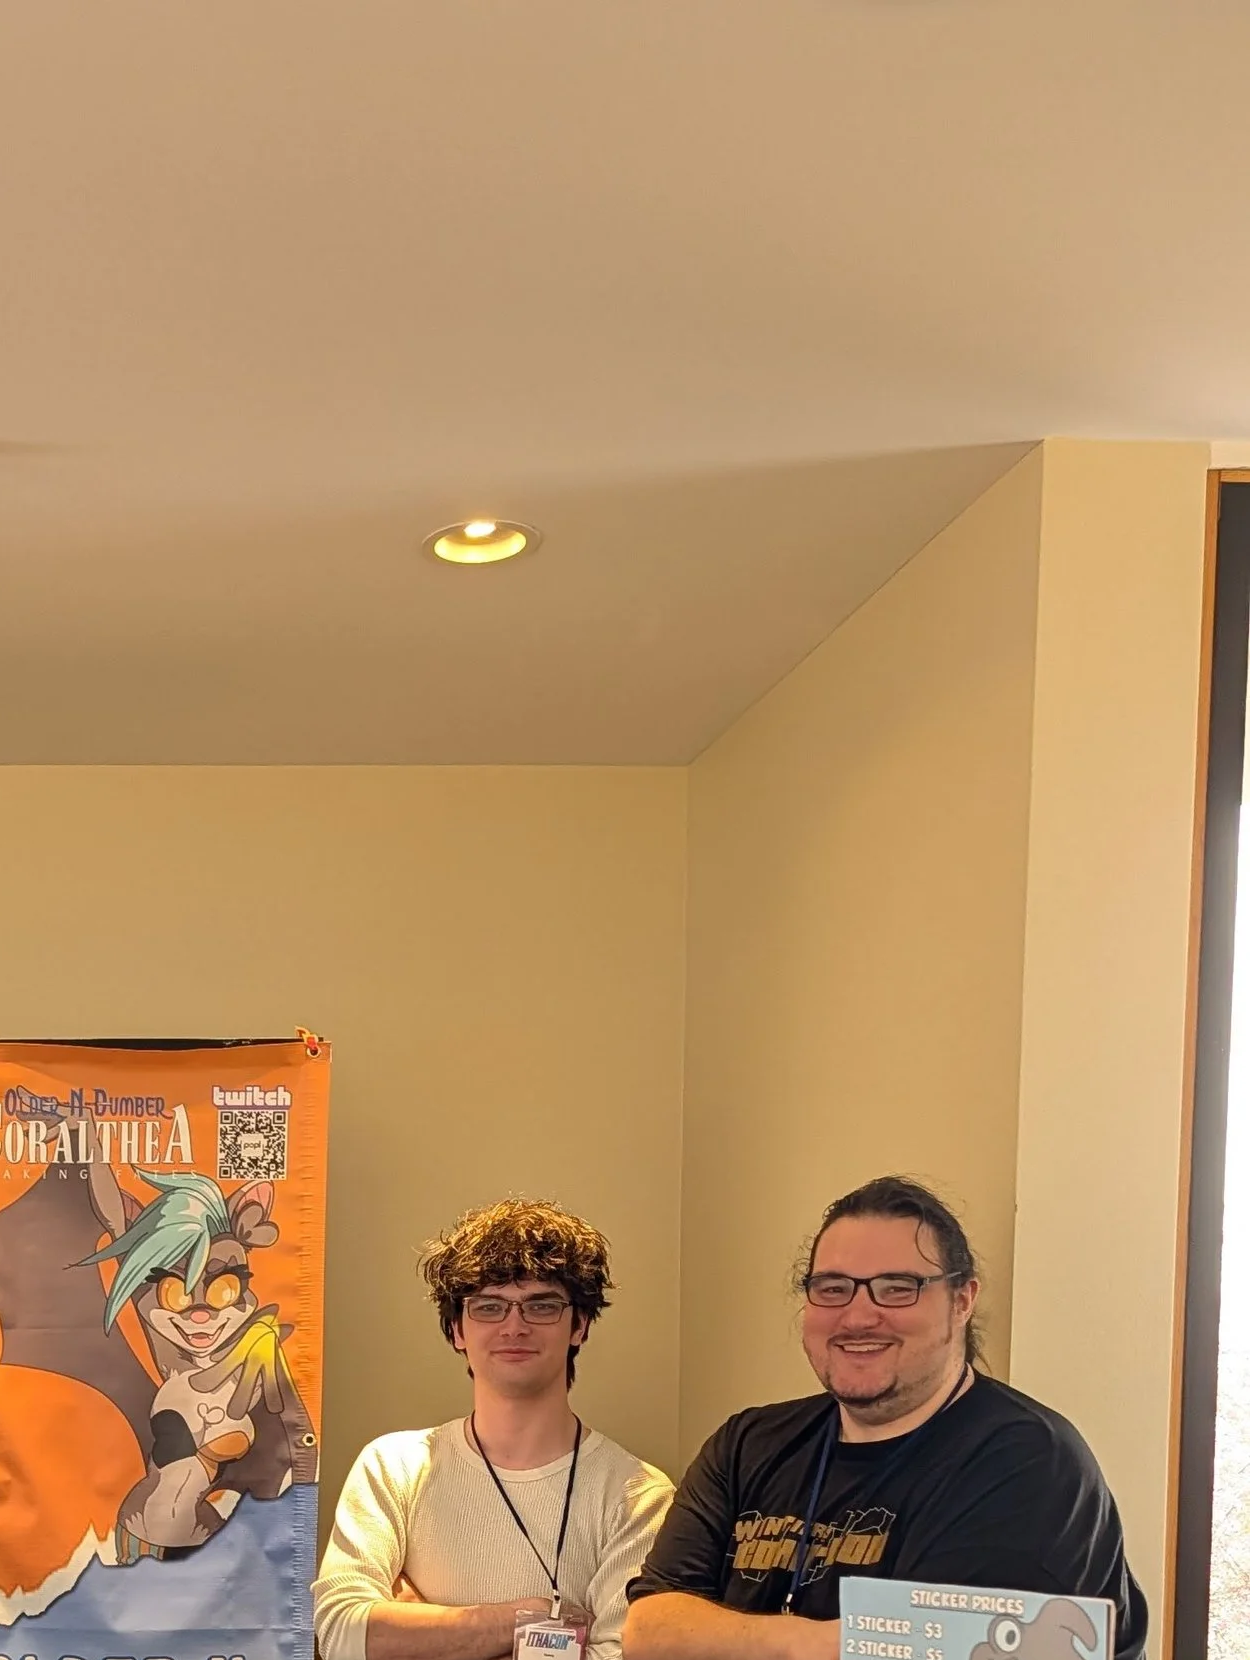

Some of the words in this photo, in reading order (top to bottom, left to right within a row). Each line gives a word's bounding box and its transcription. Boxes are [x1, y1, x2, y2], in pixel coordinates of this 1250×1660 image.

[213, 1085, 292, 1109] twitch
[244, 1141, 261, 1150] popl
[910, 1589, 968, 1609] STICKER
[972, 1596, 1025, 1615] PRICES
[847, 1615, 854, 1630] 1
[857, 1615, 912, 1635] STICKER
[924, 1620, 943, 1639] $3
[846, 1639, 855, 1654] 2
[858, 1640, 914, 1660] STICKER
